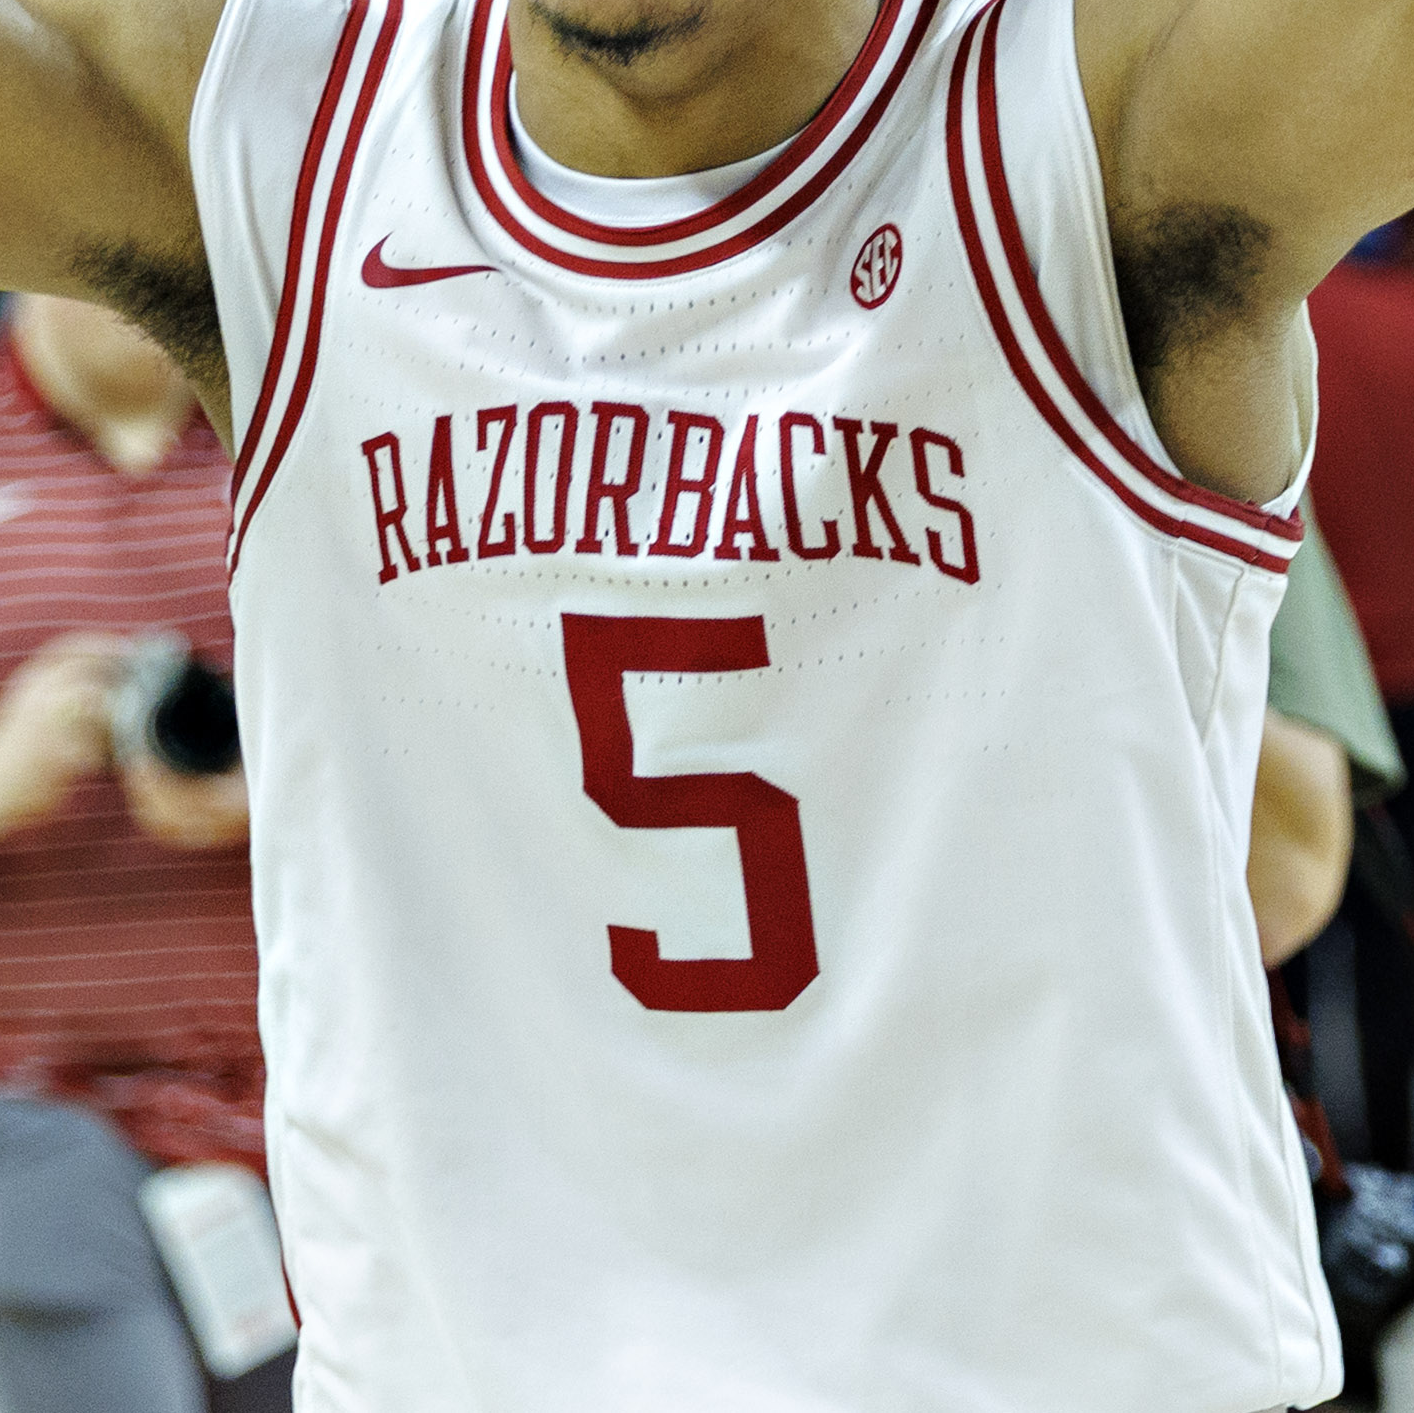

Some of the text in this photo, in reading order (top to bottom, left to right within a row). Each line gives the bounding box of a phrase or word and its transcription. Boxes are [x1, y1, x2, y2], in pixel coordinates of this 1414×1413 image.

[853, 227, 901, 305] SEC
[361, 401, 981, 585] RAZORBACKS
[560, 612, 820, 1013] 5
